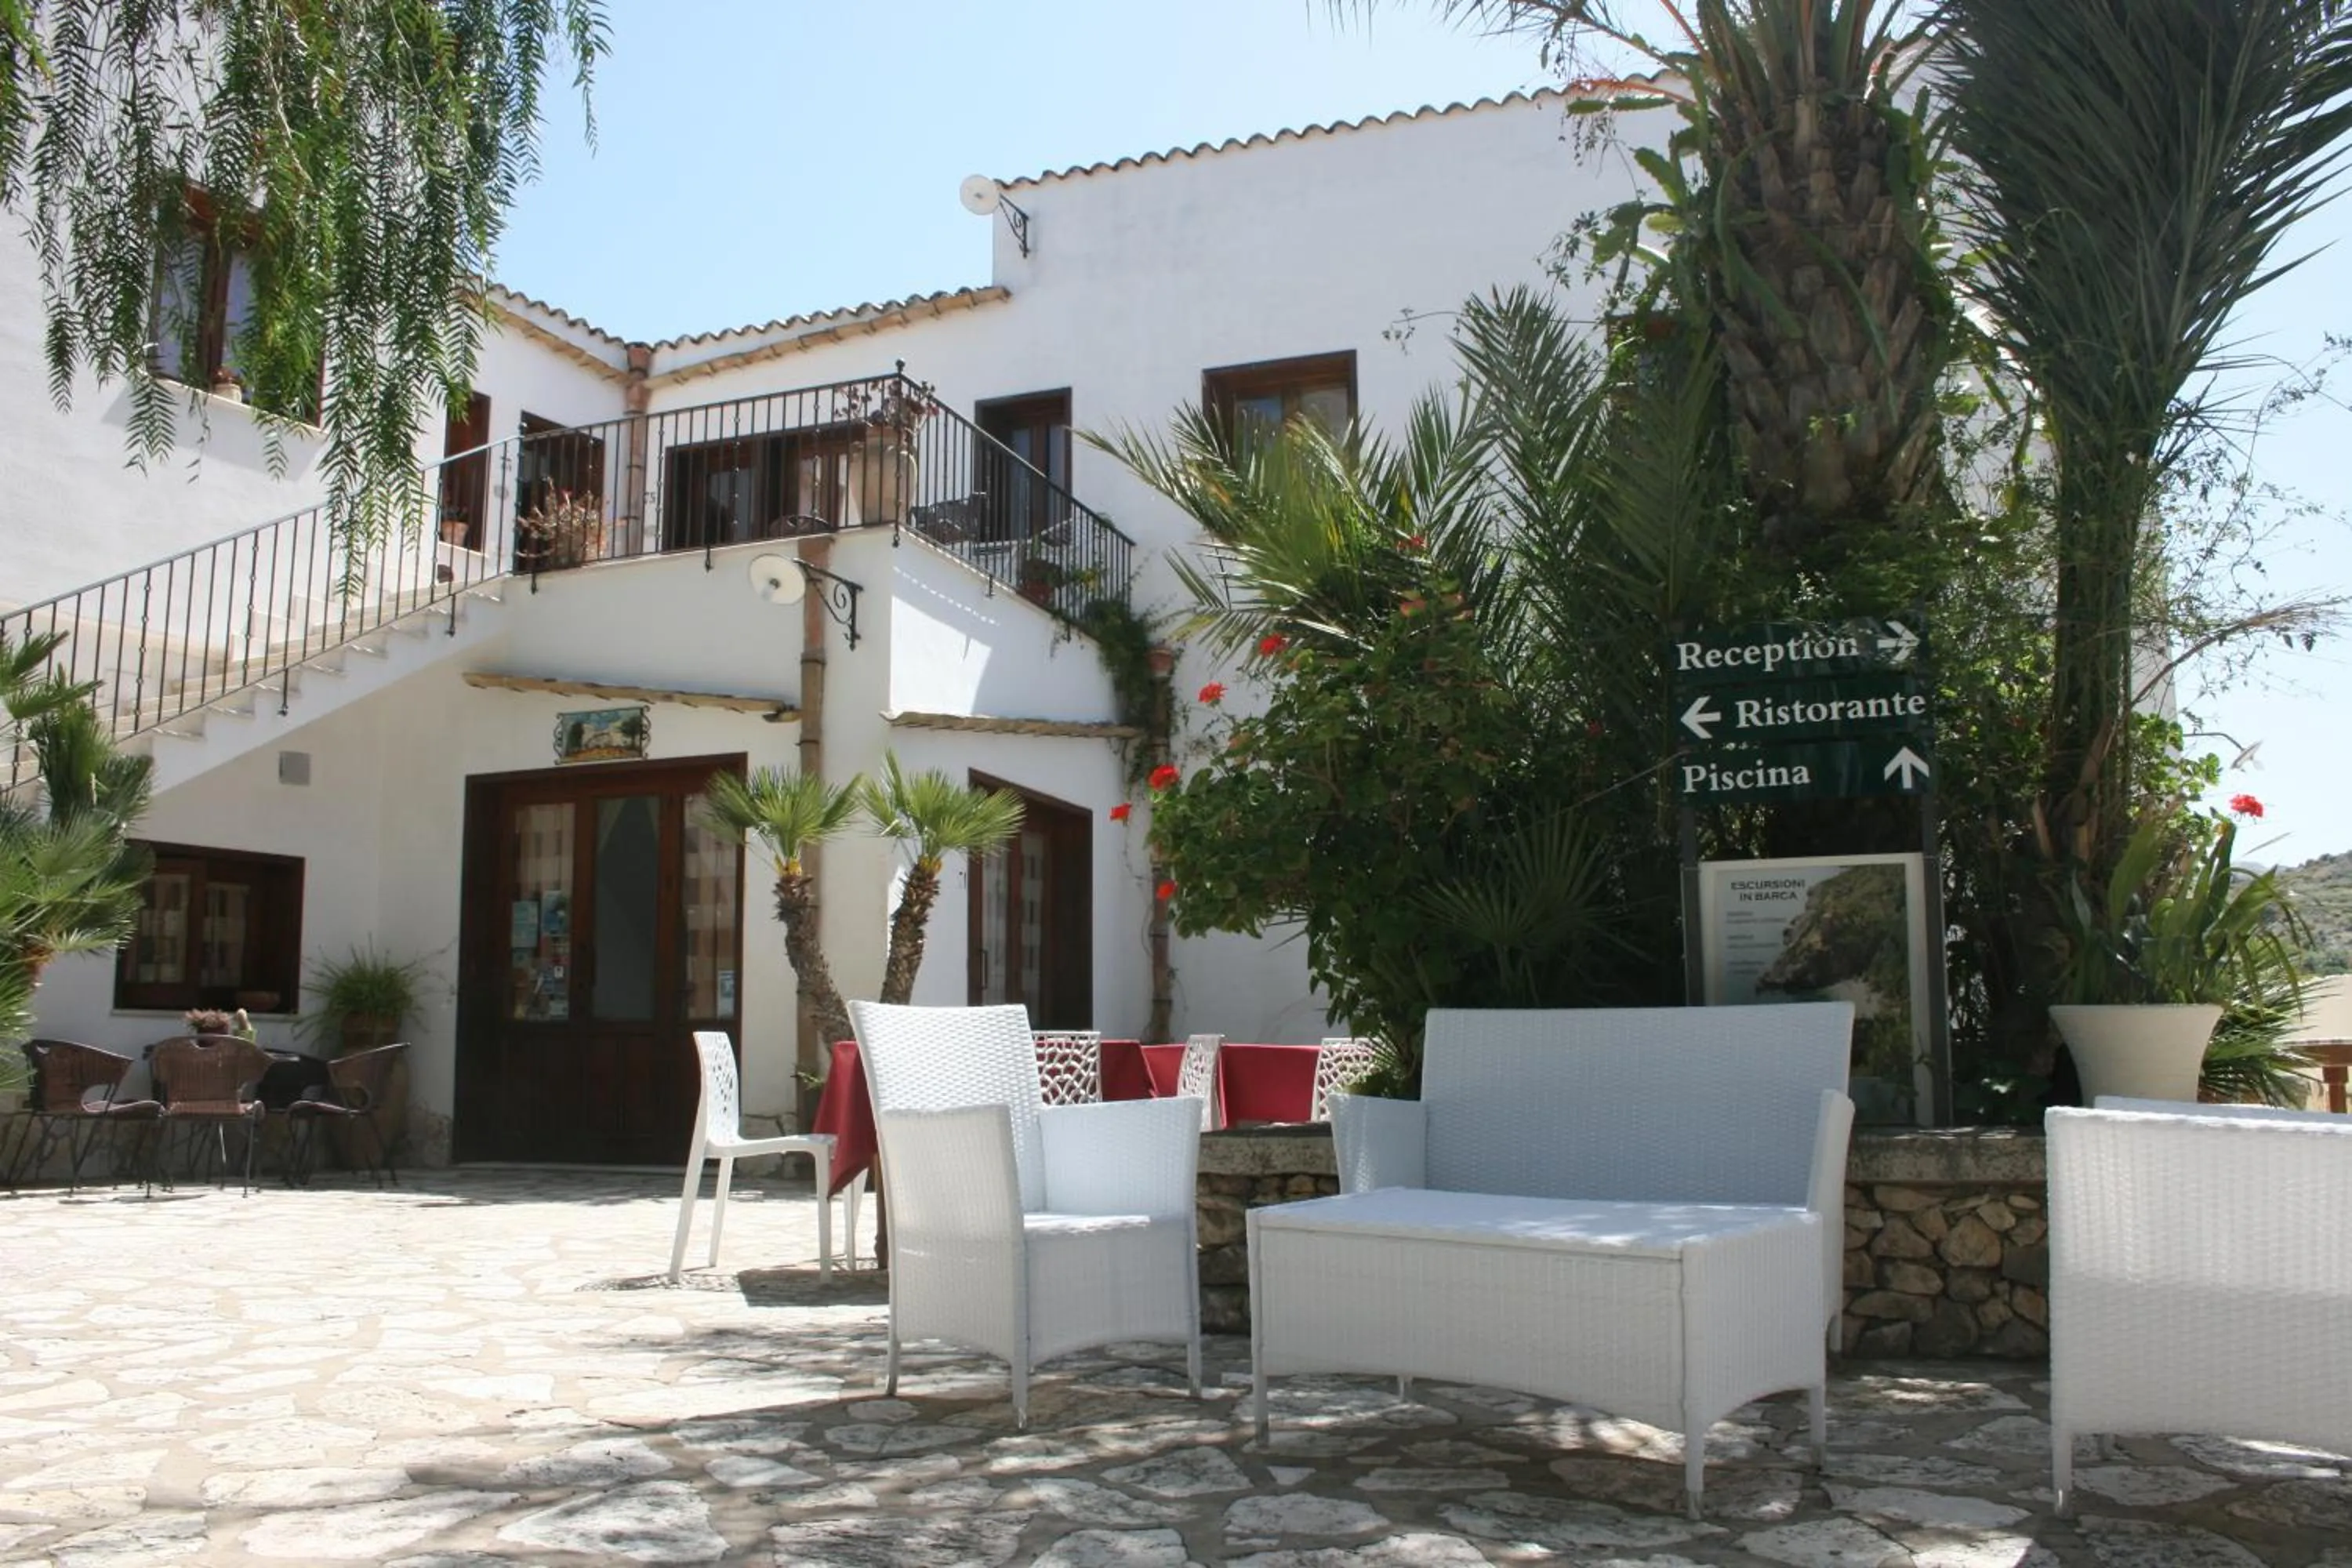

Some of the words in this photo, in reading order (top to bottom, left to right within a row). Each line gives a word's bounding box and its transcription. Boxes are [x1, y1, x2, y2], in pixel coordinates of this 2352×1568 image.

[1676, 631, 1859, 671] Reception
[1735, 691, 1926, 728] Ristorante
[1682, 759, 1810, 793] Piscina
[1730, 879, 1805, 890] ESCURSIONI
[1739, 892, 1752, 901] IN
[1755, 891, 1798, 900] BARCA
